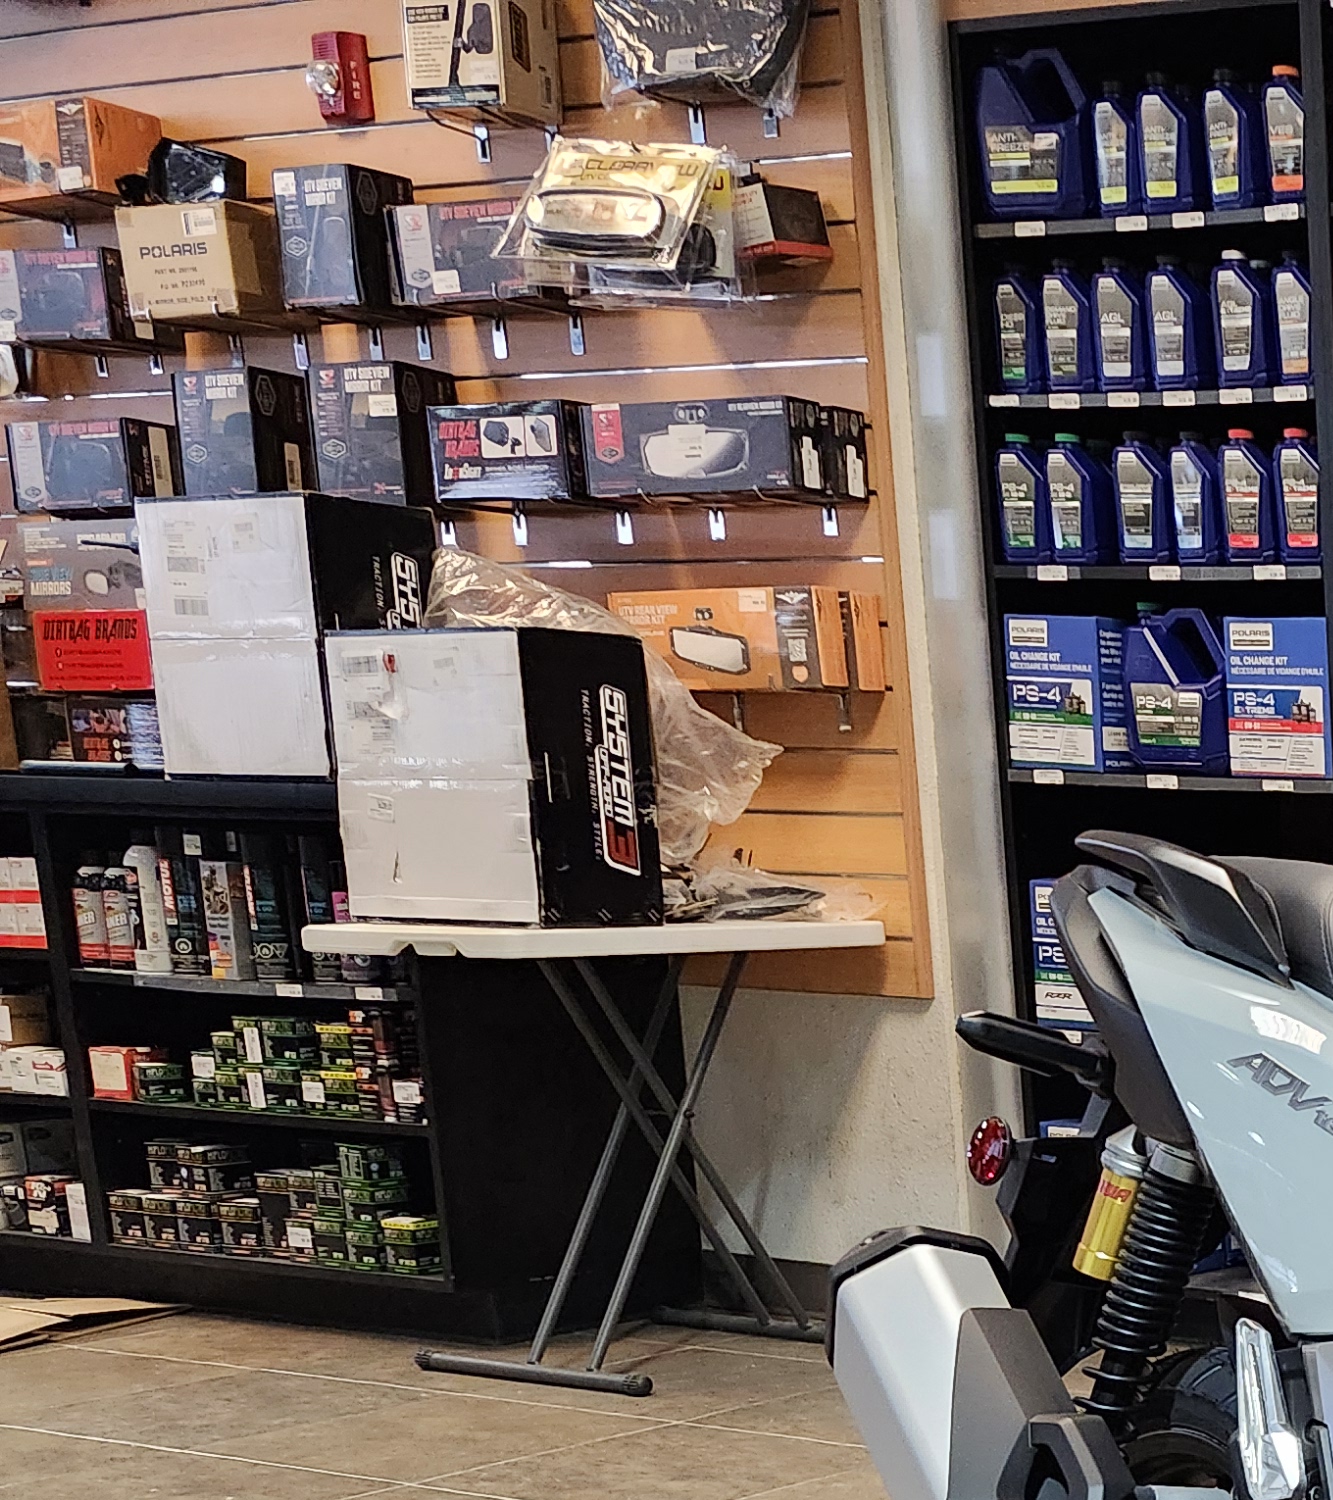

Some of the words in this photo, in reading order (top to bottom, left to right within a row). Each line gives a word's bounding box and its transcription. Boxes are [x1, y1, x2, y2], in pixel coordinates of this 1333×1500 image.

[349, 60, 362, 100] FIRE
[138, 241, 208, 260] POLARIS
[1100, 312, 1125, 324] AGL
[1153, 311, 1178, 322] AGL
[657, 604, 678, 615] VIEW
[43, 618, 91, 643] DIRTBAG
[95, 618, 138, 643] BRANDS
[1011, 626, 1045, 634] POLARIS
[1231, 629, 1271, 637] POLARIS
[1049, 652, 1061, 662] KIT
[1243, 655, 1275, 666] CHANGE
[1275, 656, 1288, 666] KIT
[1013, 683, 1062, 703] PS-4
[1233, 692, 1276, 706] PS-4
[1135, 694, 1173, 709] PS-4
[605, 686, 634, 828] SYSTEM
[158, 859, 176, 909] MOTUL
[1045, 991, 1073, 1000] RZR
